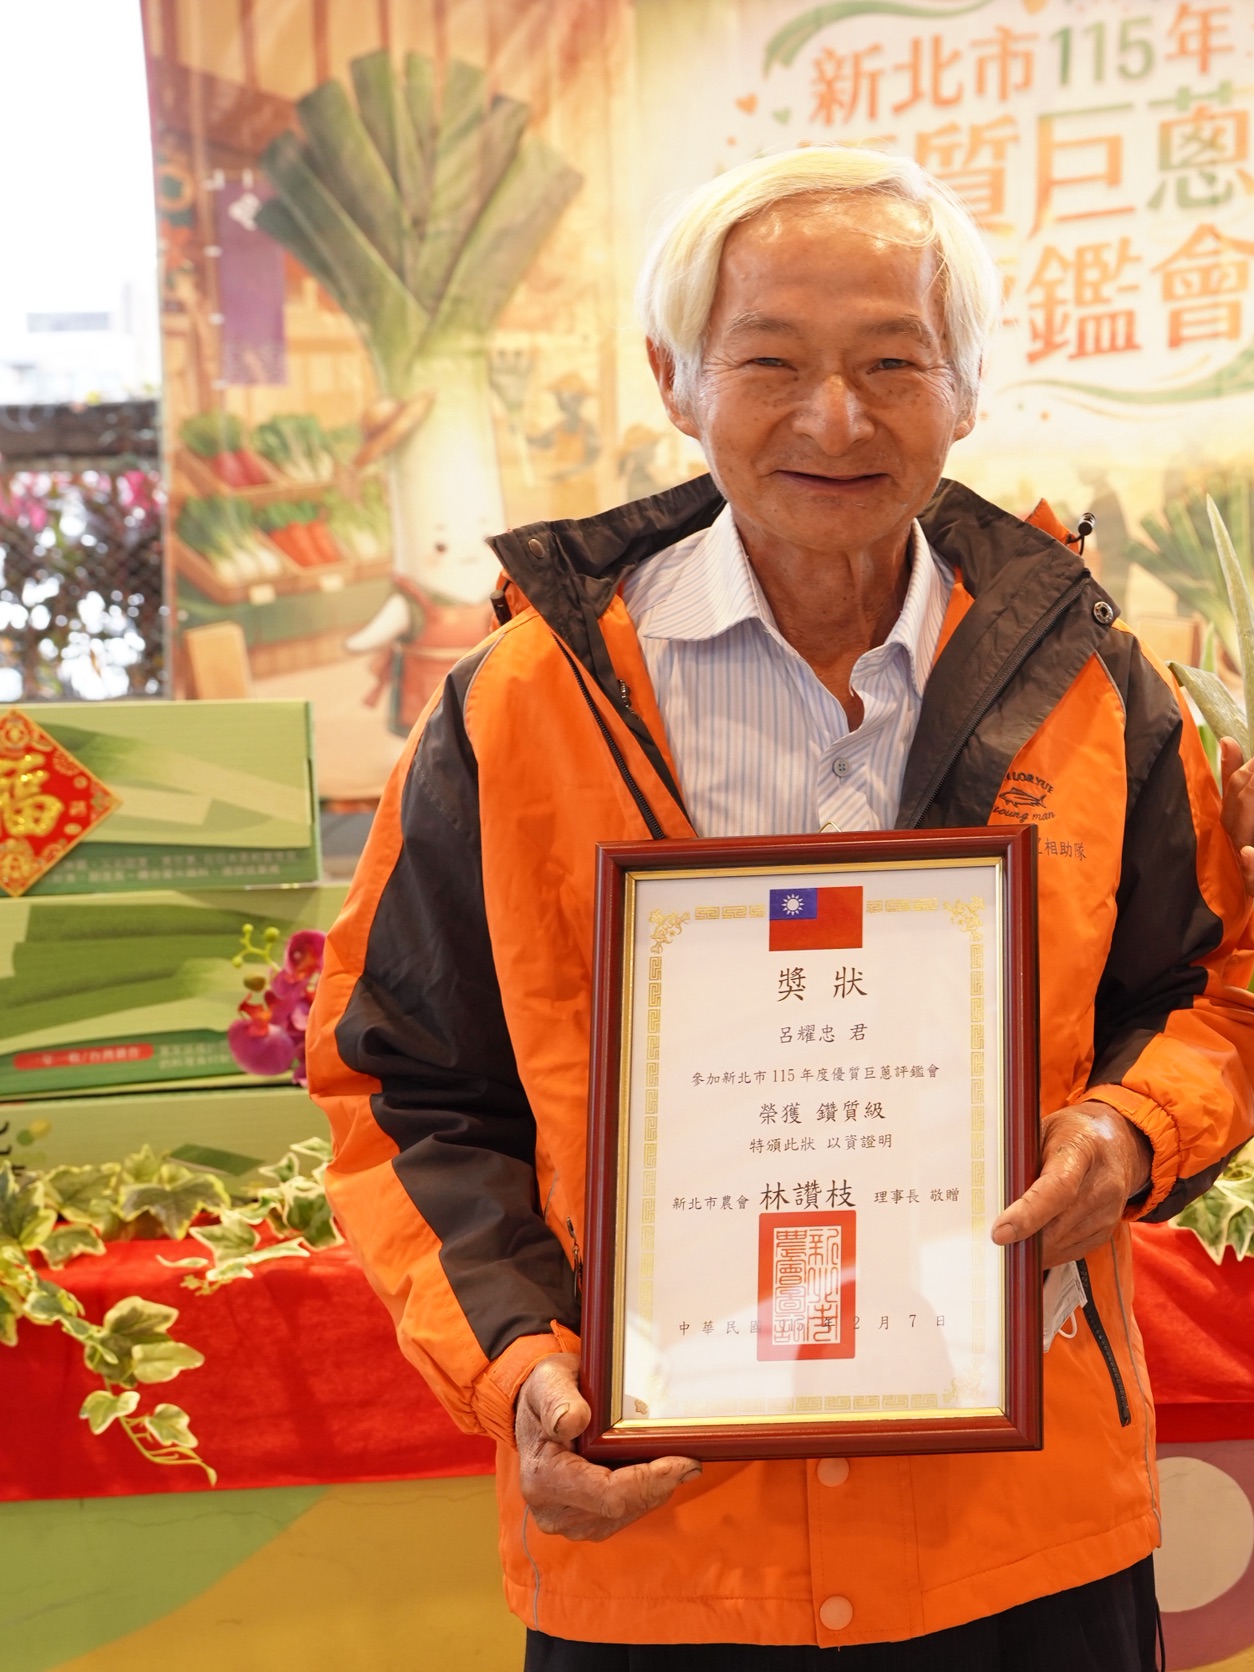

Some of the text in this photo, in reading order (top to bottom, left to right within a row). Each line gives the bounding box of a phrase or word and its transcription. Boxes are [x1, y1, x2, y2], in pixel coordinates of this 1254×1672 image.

[809, 3, 1236, 125] 新北市115年
[777, 966, 868, 1002] 獎狀
[779, 1023, 868, 1044] 呂耀忠 君
[759, 1100, 886, 1125] 榮獲 鑽質級
[749, 1133, 892, 1154] 特頒此狀 以資證明
[672, 1179, 960, 1211] 新北市農會 林讚枝 理事長 敬贈
